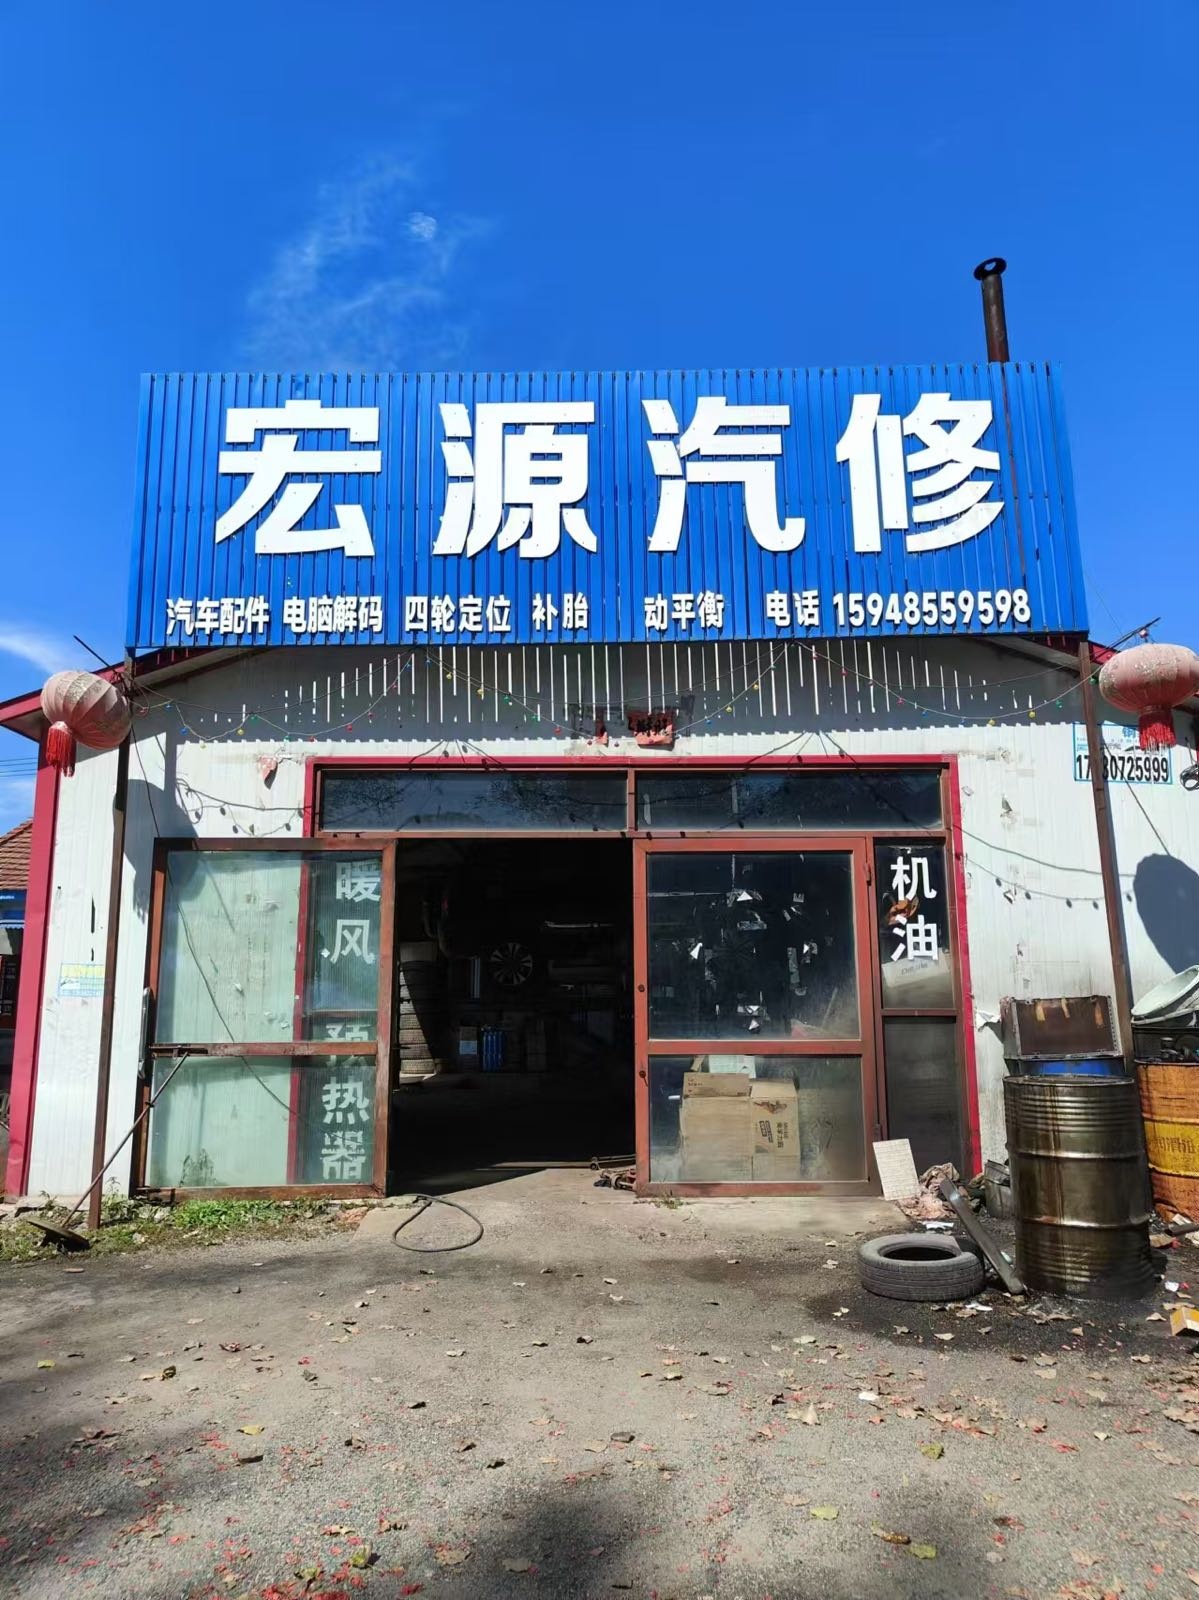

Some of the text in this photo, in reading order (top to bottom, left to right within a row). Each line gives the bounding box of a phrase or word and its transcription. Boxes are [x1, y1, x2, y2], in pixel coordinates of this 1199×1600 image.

[216, 393, 1005, 558] 宏源汽修
[166, 589, 1031, 635] 汽车配件 电脑解码 四轮定位 补胎 动平衡 电话 15948559598
[330, 861, 381, 964] 暖风
[890, 856, 938, 962] 机油
